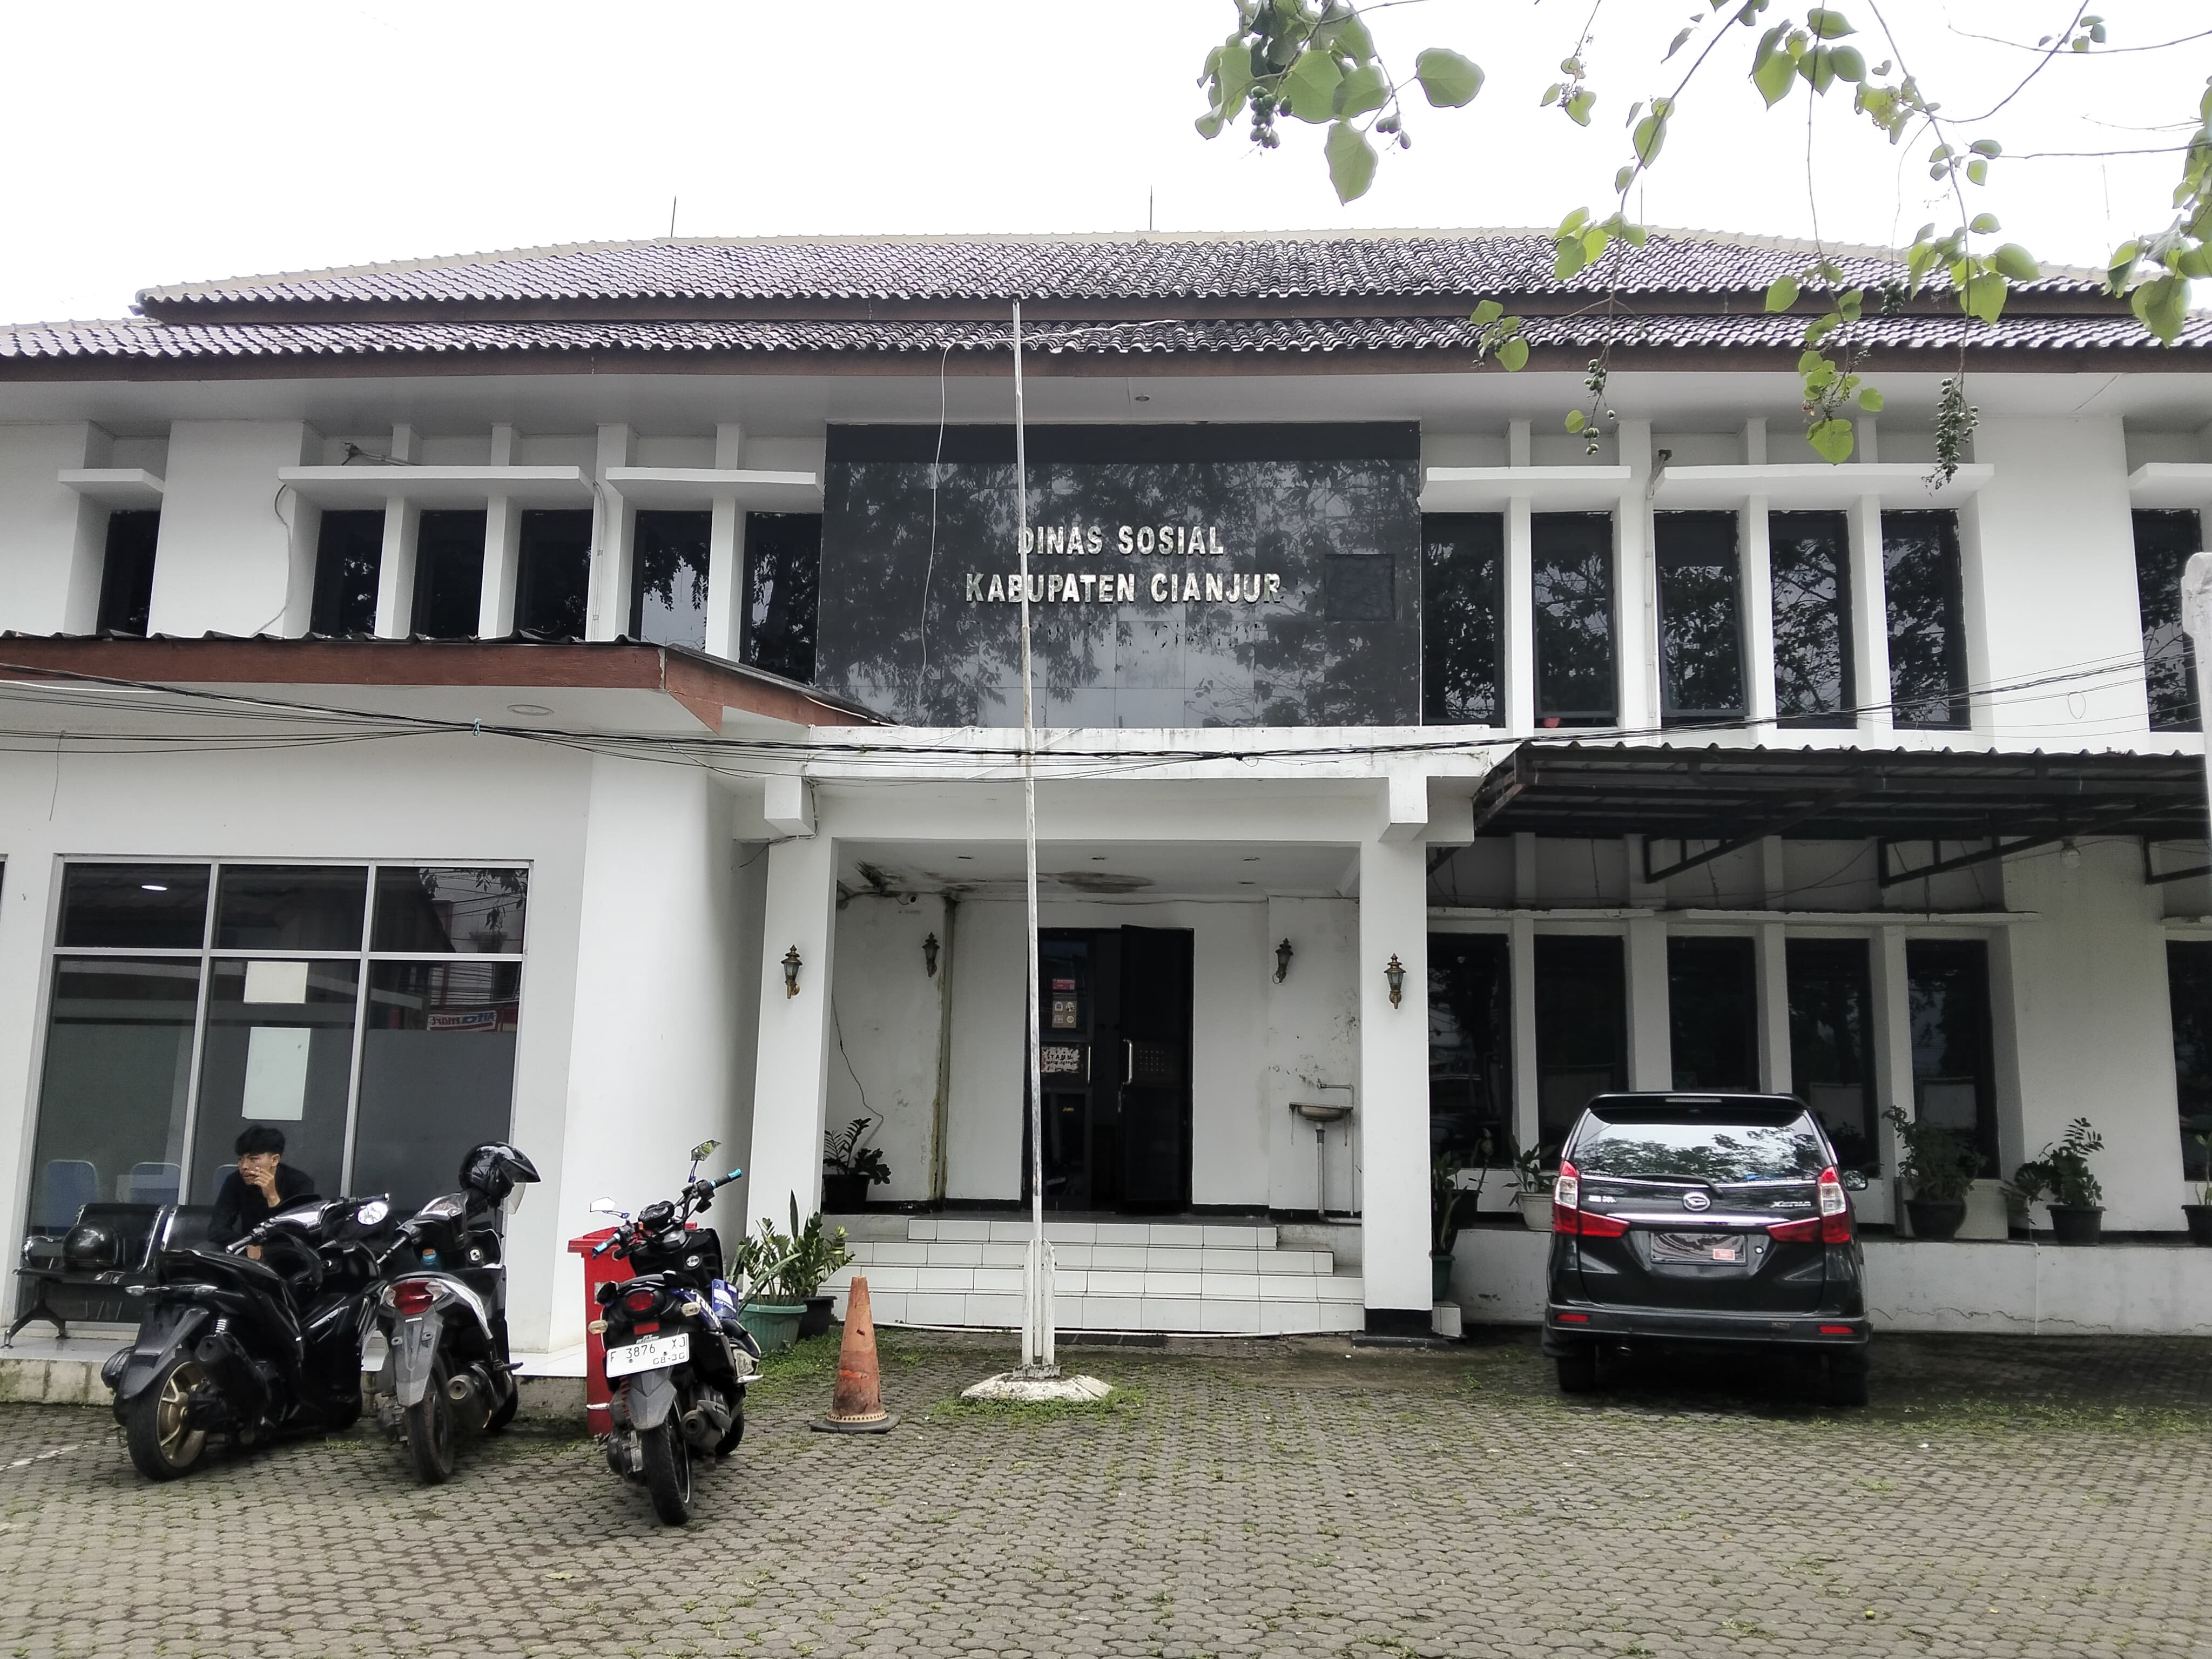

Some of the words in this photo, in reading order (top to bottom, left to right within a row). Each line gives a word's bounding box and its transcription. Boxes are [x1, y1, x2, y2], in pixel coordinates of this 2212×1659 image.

[1018, 525, 1103, 555] DINAS
[1118, 525, 1224, 555] SOSIAL
[966, 573, 1135, 603] KABUPATEN
[1151, 573, 1282, 603] CIANJUR
[610, 1351, 617, 1363] F
[626, 1343, 656, 1359] 3876
